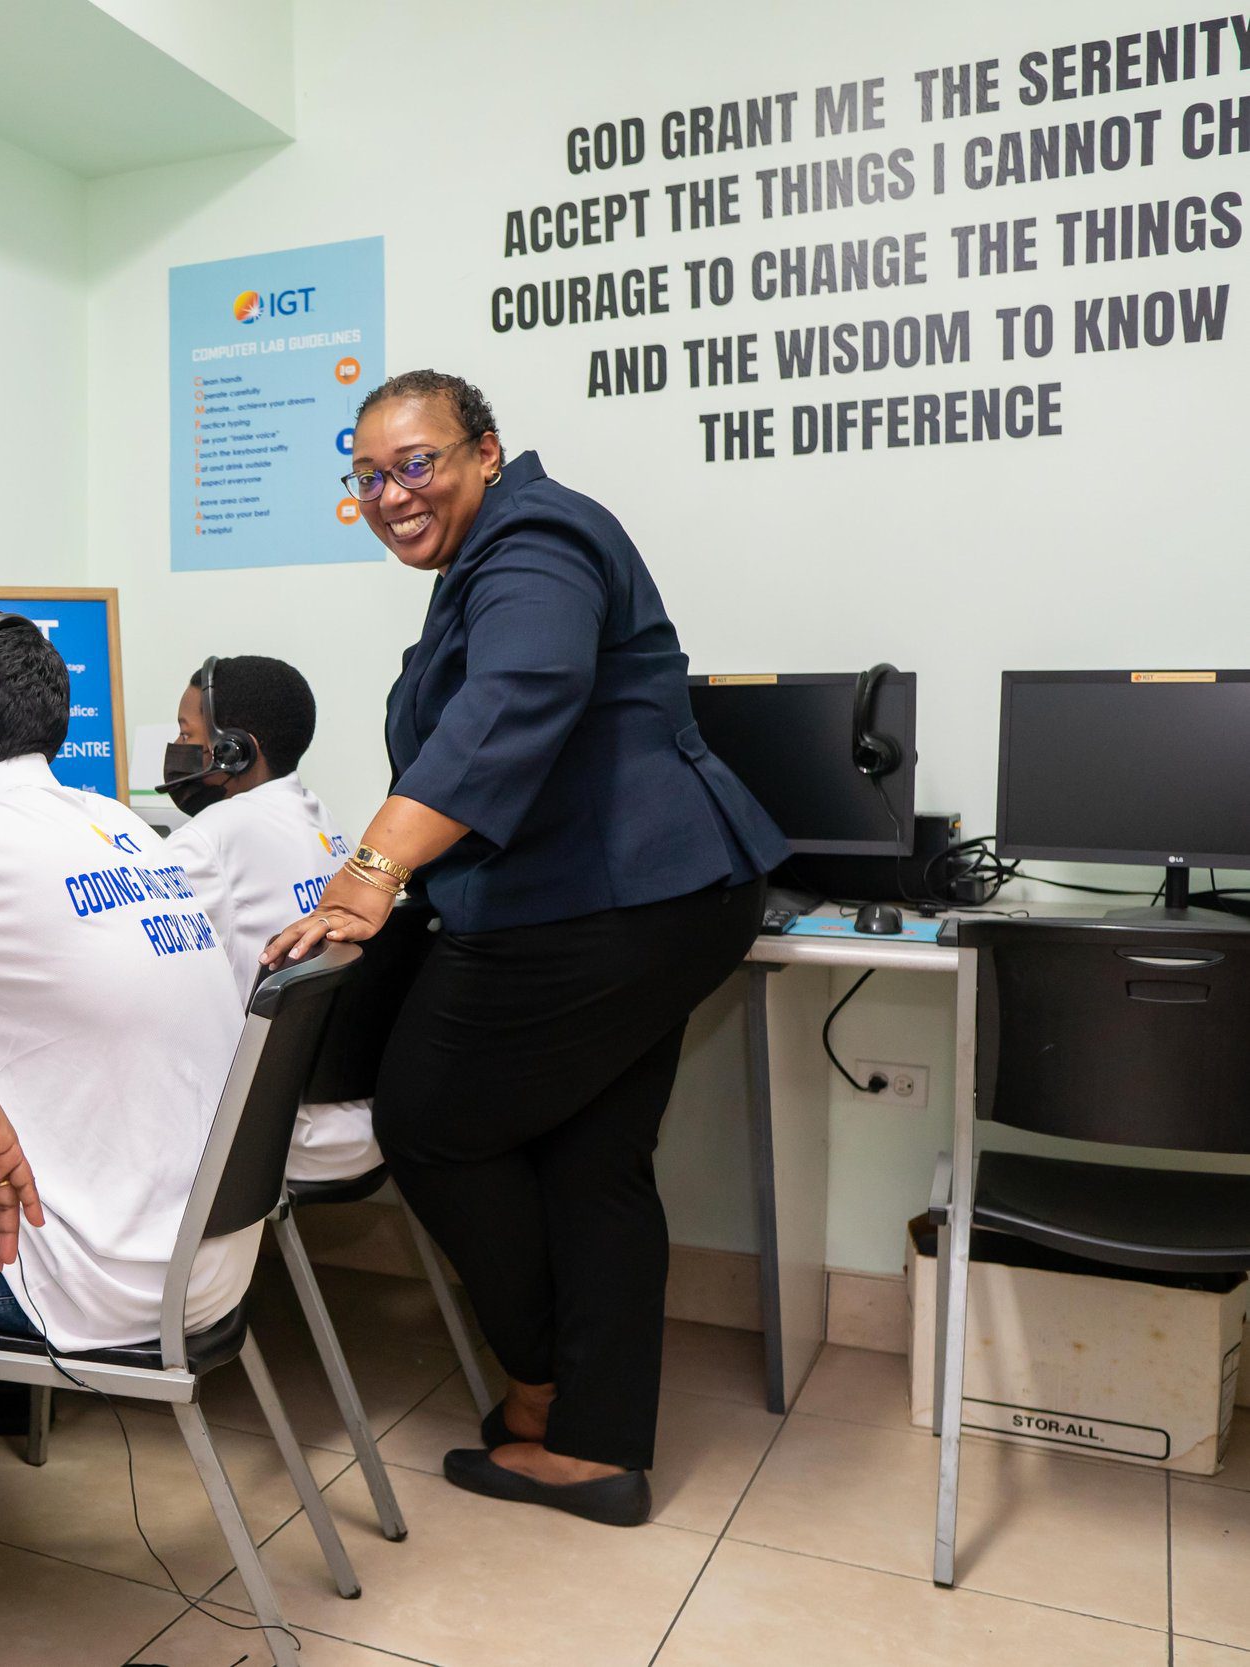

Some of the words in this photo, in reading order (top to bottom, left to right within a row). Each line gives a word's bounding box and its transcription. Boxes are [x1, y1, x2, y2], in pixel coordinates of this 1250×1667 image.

[566, 117, 646, 175] GOD
[661, 92, 798, 160] GRANT
[814, 77, 885, 138] ME
[913, 58, 1000, 123] THE
[1018, 14, 1250, 106] SERENITY
[504, 189, 651, 258] ACCEPT
[665, 174, 741, 232] THE
[756, 148, 915, 220] THINGS
[933, 142, 945, 195] I
[963, 109, 1162, 190] CANNOT
[269, 287, 316, 317] IGT
[491, 264, 670, 333] COURAGE
[684, 256, 734, 309] TO
[751, 232, 927, 301] CHANGE
[950, 217, 1038, 279] THE
[1056, 190, 1243, 267] THINGS
[192, 342, 257, 362] COMPUTER
[260, 338, 285, 353] LAB
[288, 329, 362, 350] GUIDELINES
[587, 344, 668, 398] AND
[683, 333, 759, 388] THE
[774, 310, 971, 380] WISDOM
[995, 303, 1053, 361] TO
[1074, 284, 1231, 354] KNOW
[699, 408, 775, 462] THE
[792, 382, 1063, 456] DIFFERENCE
[65, 866, 146, 918] CODING
